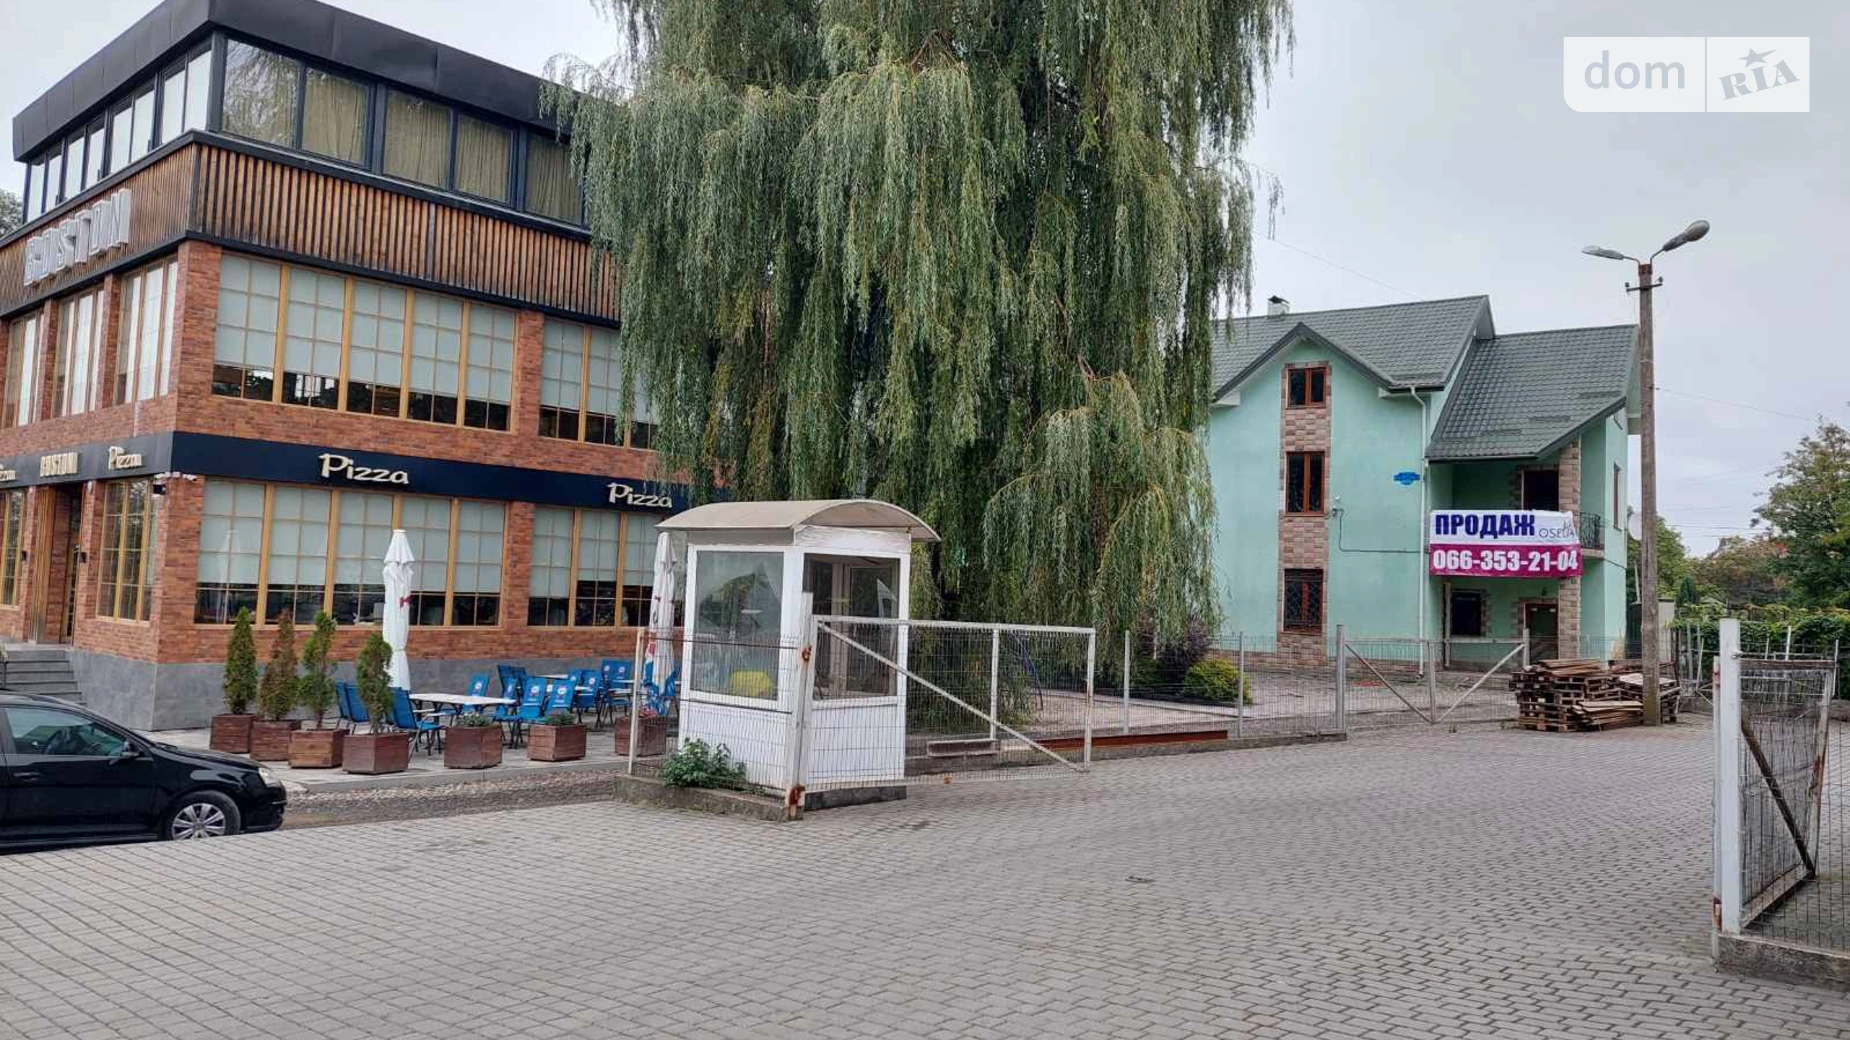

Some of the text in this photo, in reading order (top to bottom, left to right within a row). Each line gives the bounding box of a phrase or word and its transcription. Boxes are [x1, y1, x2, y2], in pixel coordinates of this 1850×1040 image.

[24, 188, 131, 286] BOSTON
[108, 446, 142, 469] Pizza
[319, 453, 409, 485] Pizza
[608, 482, 673, 509] Pizza
[1435, 514, 1536, 539] ПРОДАЖ
[1433, 550, 1579, 572] 066-353-21-04
